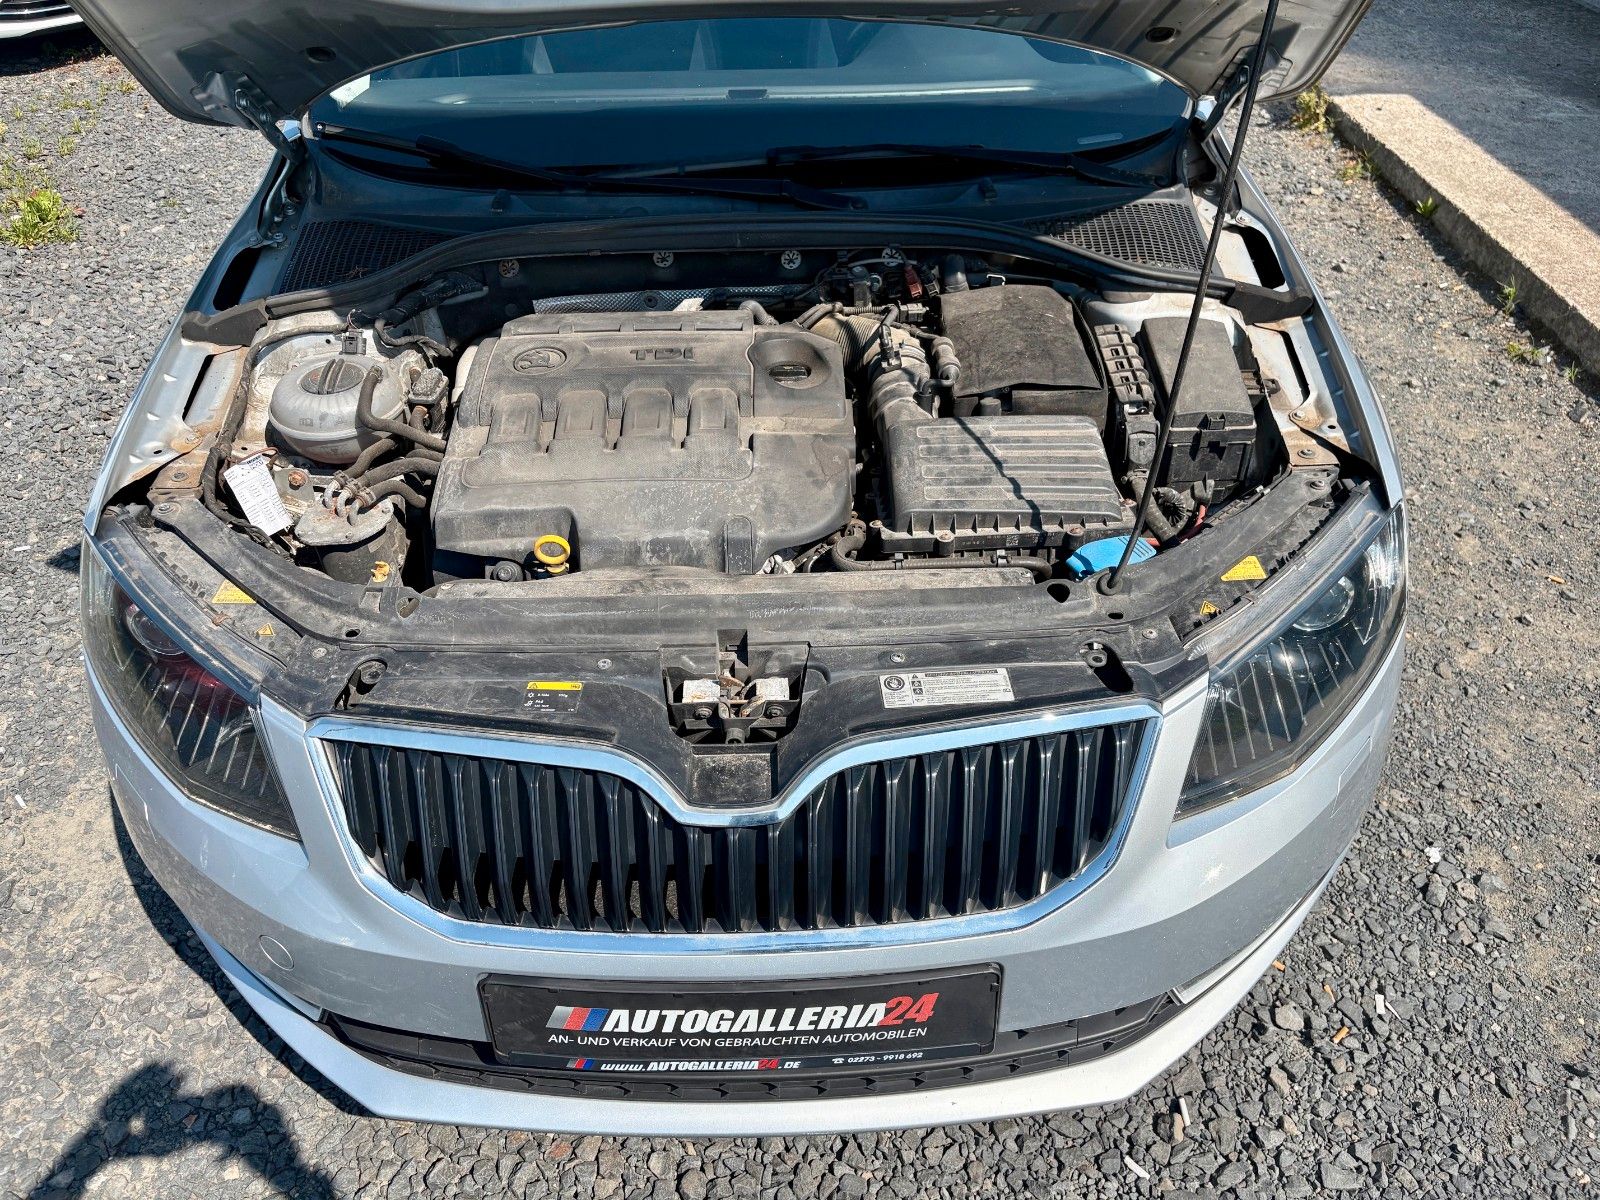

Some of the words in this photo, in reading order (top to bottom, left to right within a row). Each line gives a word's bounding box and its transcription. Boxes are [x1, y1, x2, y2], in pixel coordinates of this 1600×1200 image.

[629, 347, 695, 361] TDI
[602, 992, 939, 1034] AUTOGALLERIA24
[548, 1034, 574, 1044] AN-
[577, 1036, 610, 1046] UND
[612, 1037, 677, 1047] VERKAUF
[680, 1038, 712, 1047] VON
[714, 1035, 820, 1047] GEBRAUCHTEN
[822, 1027, 927, 1044] AUTOMOBILEN
[847, 1055, 874, 1063] 02273
[906, 1052, 923, 1060] 692
